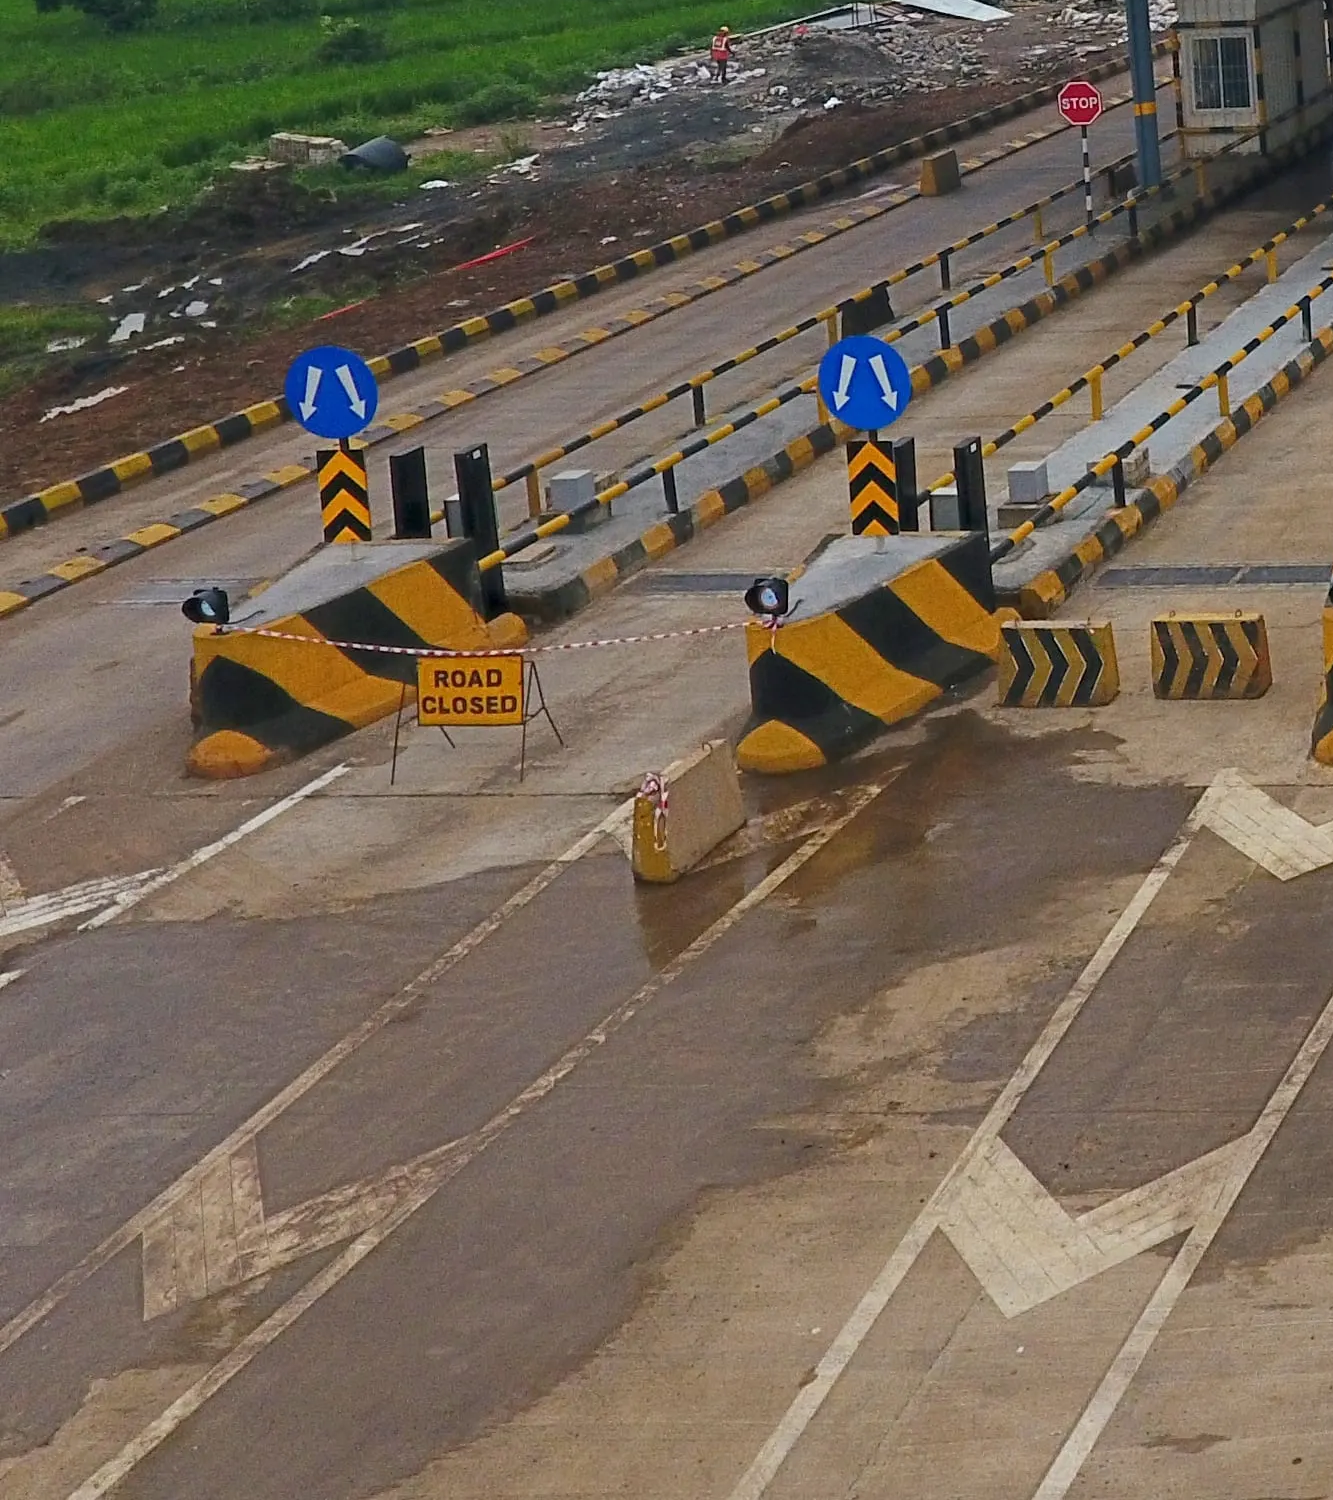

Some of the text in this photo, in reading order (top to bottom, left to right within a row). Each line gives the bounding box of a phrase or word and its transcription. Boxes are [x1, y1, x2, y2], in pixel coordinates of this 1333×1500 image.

[1061, 97, 1098, 110] STOP
[433, 668, 503, 689] ROAD
[421, 695, 518, 715] CLOSED
